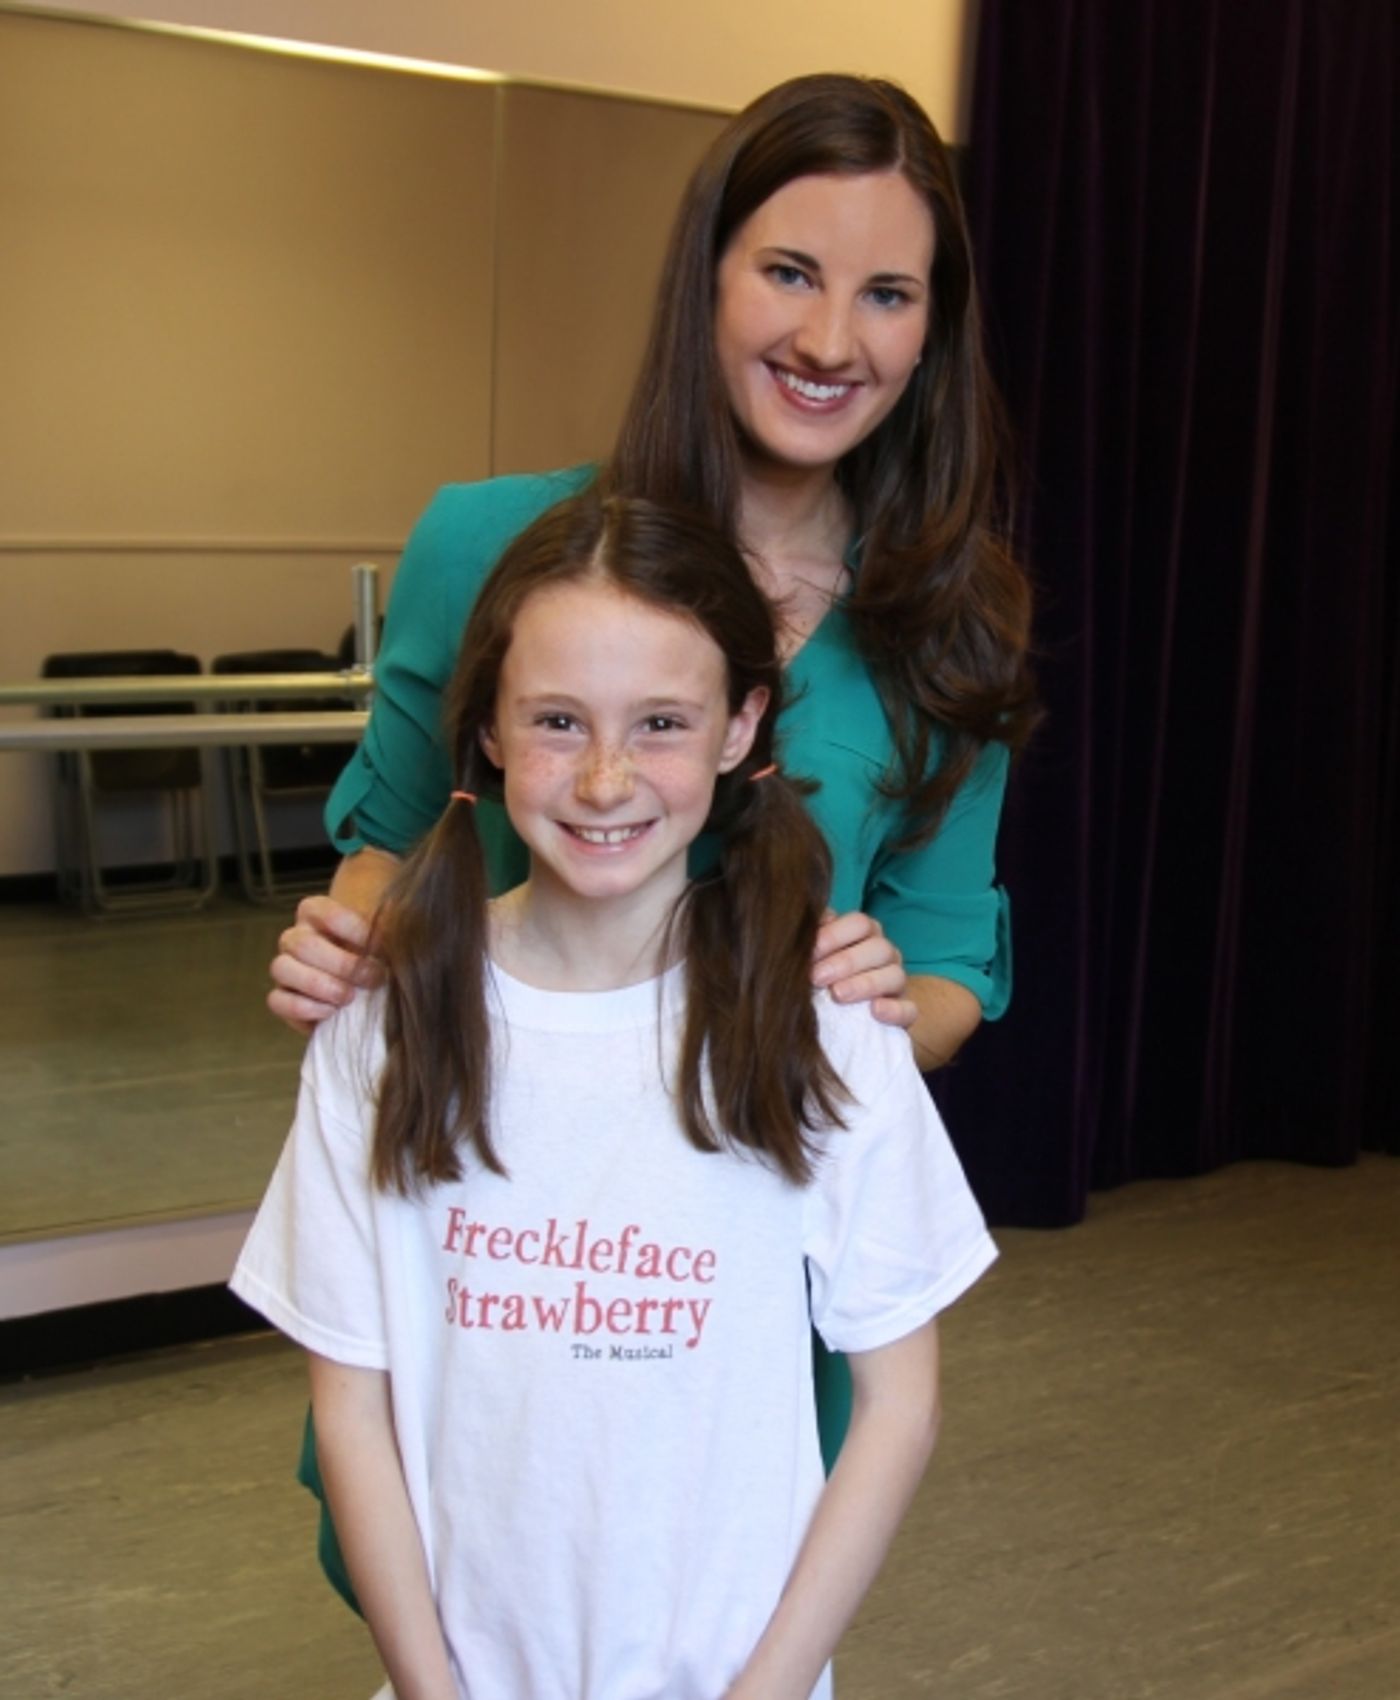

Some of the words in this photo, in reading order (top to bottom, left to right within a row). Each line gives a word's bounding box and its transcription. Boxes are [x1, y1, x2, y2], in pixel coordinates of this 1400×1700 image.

[442, 1206, 717, 1283] Freckleface
[445, 1277, 713, 1349] Strawberry
[571, 1343, 602, 1359] The
[608, 1344, 674, 1361] Musical
